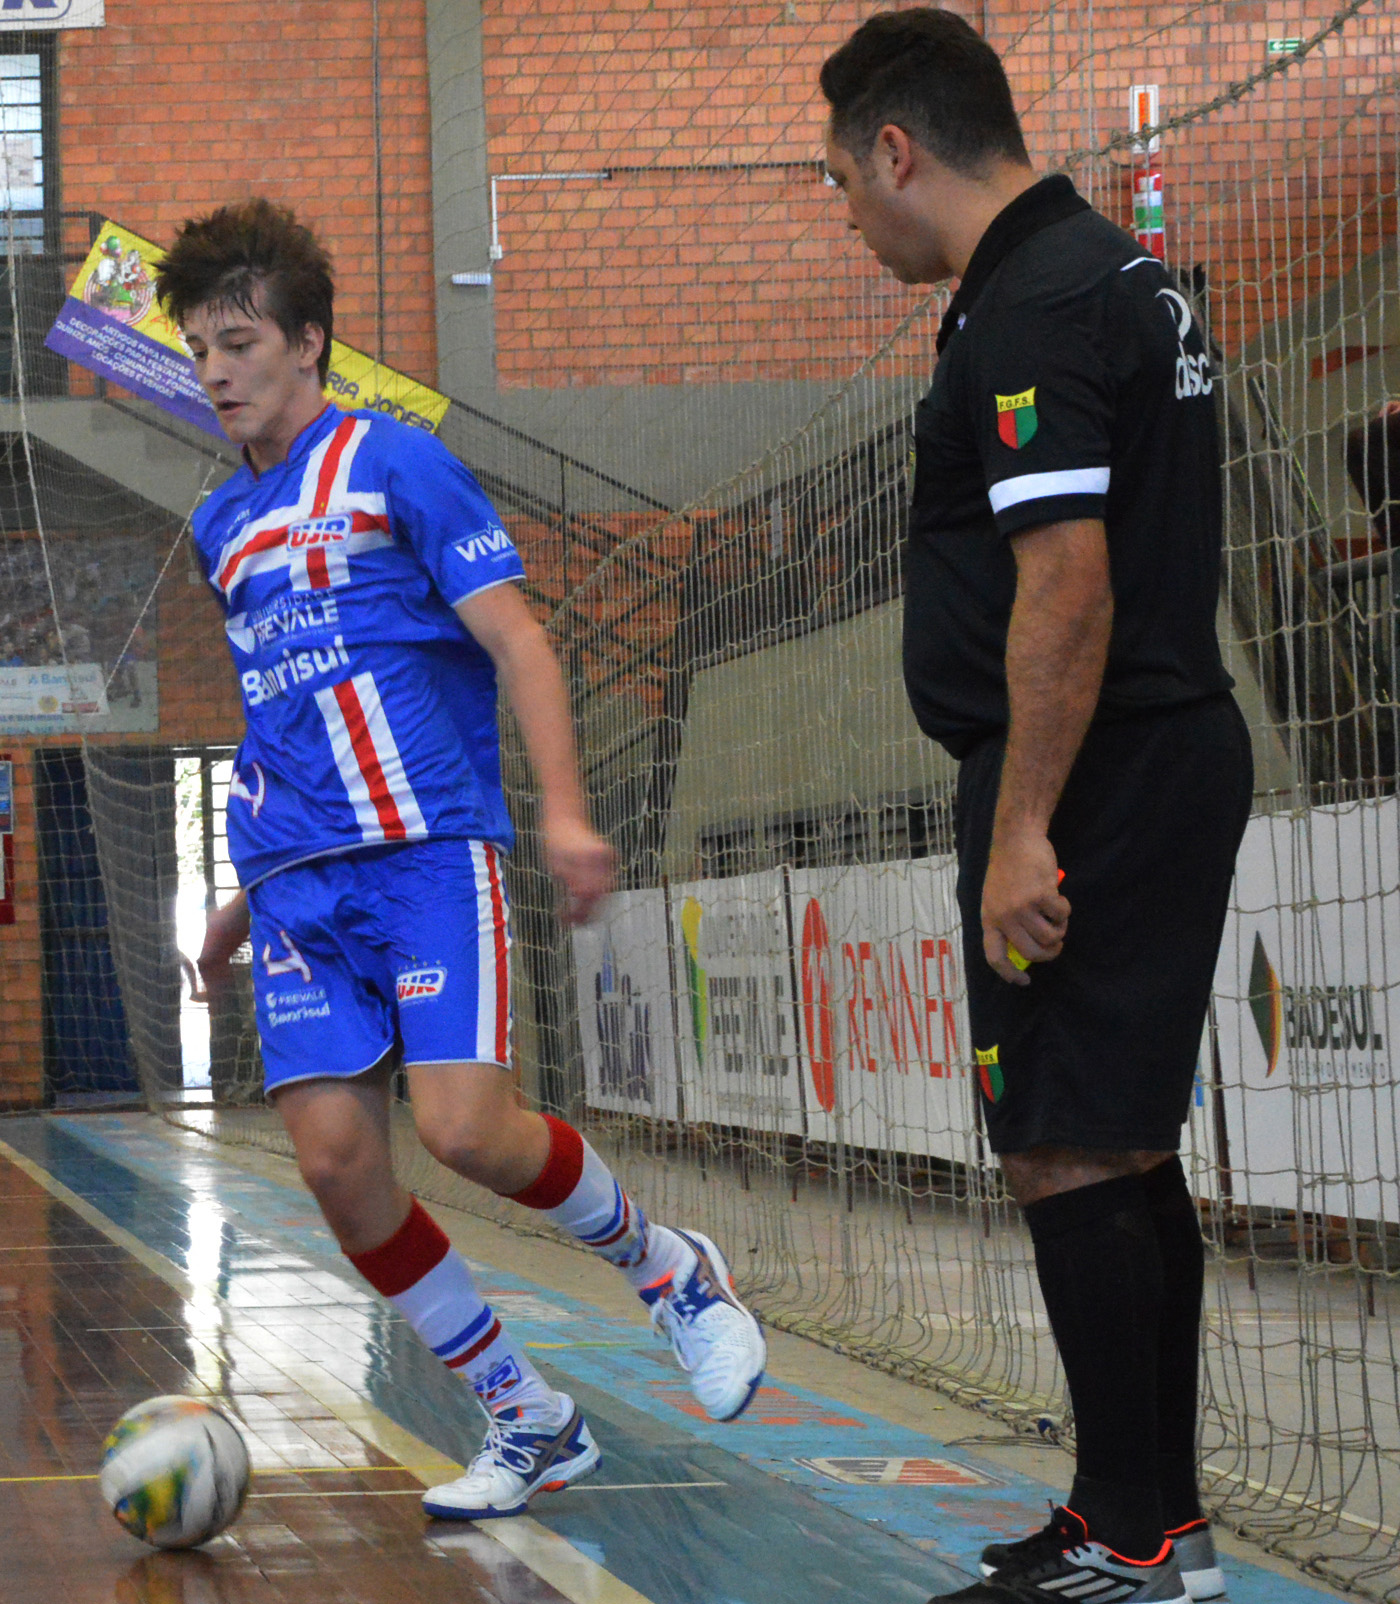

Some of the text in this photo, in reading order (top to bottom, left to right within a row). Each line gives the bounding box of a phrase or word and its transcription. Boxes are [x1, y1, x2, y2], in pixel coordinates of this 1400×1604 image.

[147, 356, 178, 379] FESTAS
[160, 353, 192, 376] FESTAS
[242, 634, 350, 707] Banrisul
[263, 930, 312, 983] 4
[842, 939, 965, 1079] RENNER
[1282, 985, 1383, 1051] BADESUL
